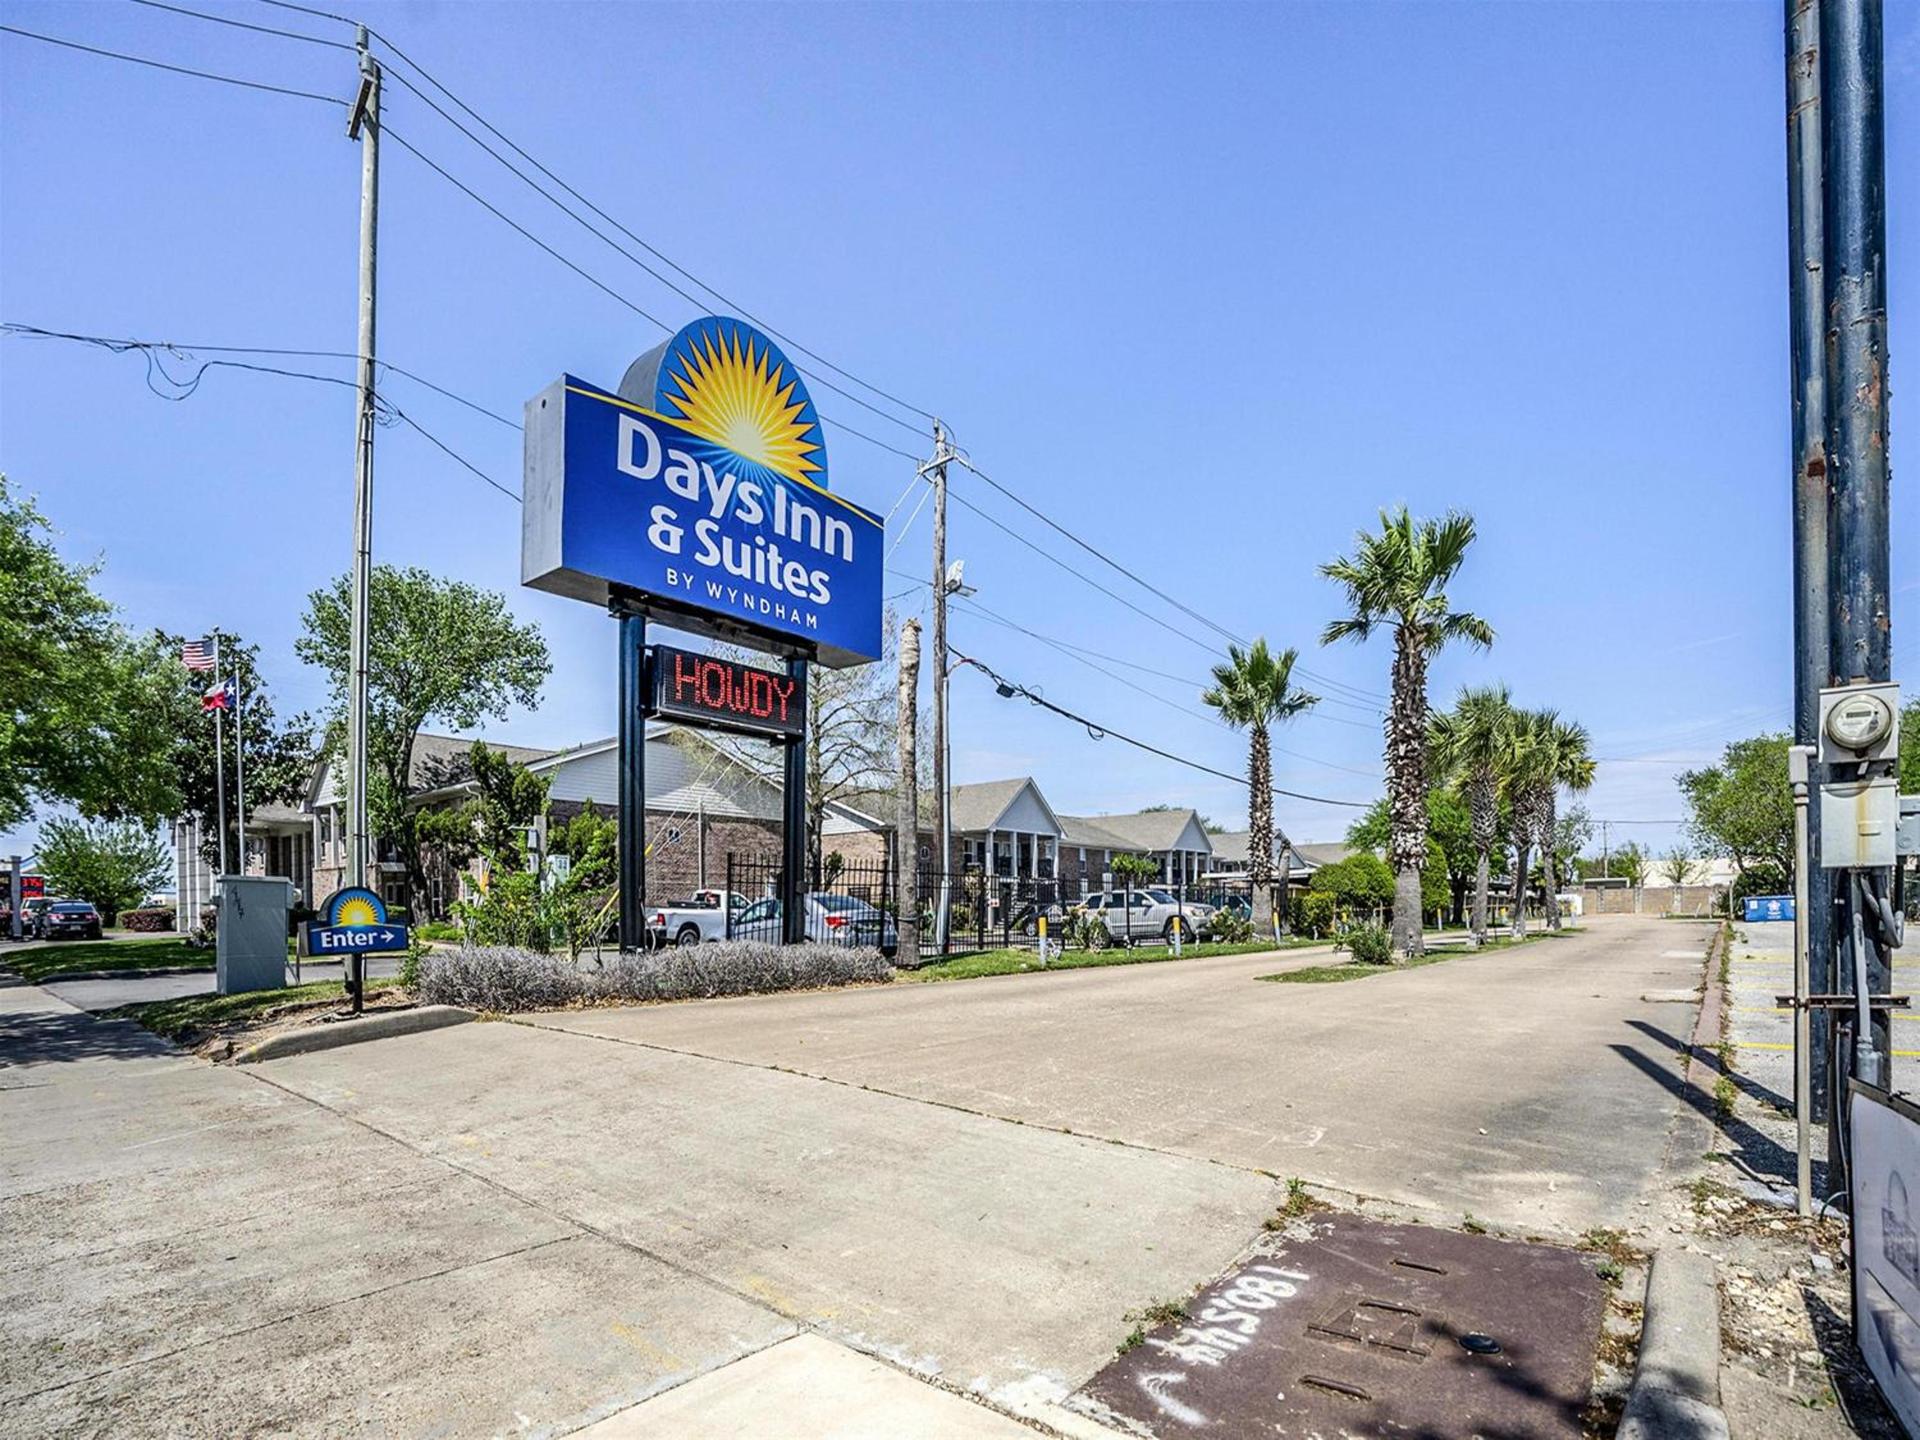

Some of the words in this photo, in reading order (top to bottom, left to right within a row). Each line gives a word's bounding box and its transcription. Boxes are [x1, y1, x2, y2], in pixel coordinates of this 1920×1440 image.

[617, 413, 764, 525] Days
[774, 483, 854, 563] Inn
[647, 505, 684, 554] &
[694, 518, 831, 605] Suites
[666, 567, 694, 590] BY
[706, 580, 818, 629] WYNDHAM
[674, 653, 795, 723] HOWDY
[320, 931, 378, 948] Enter
